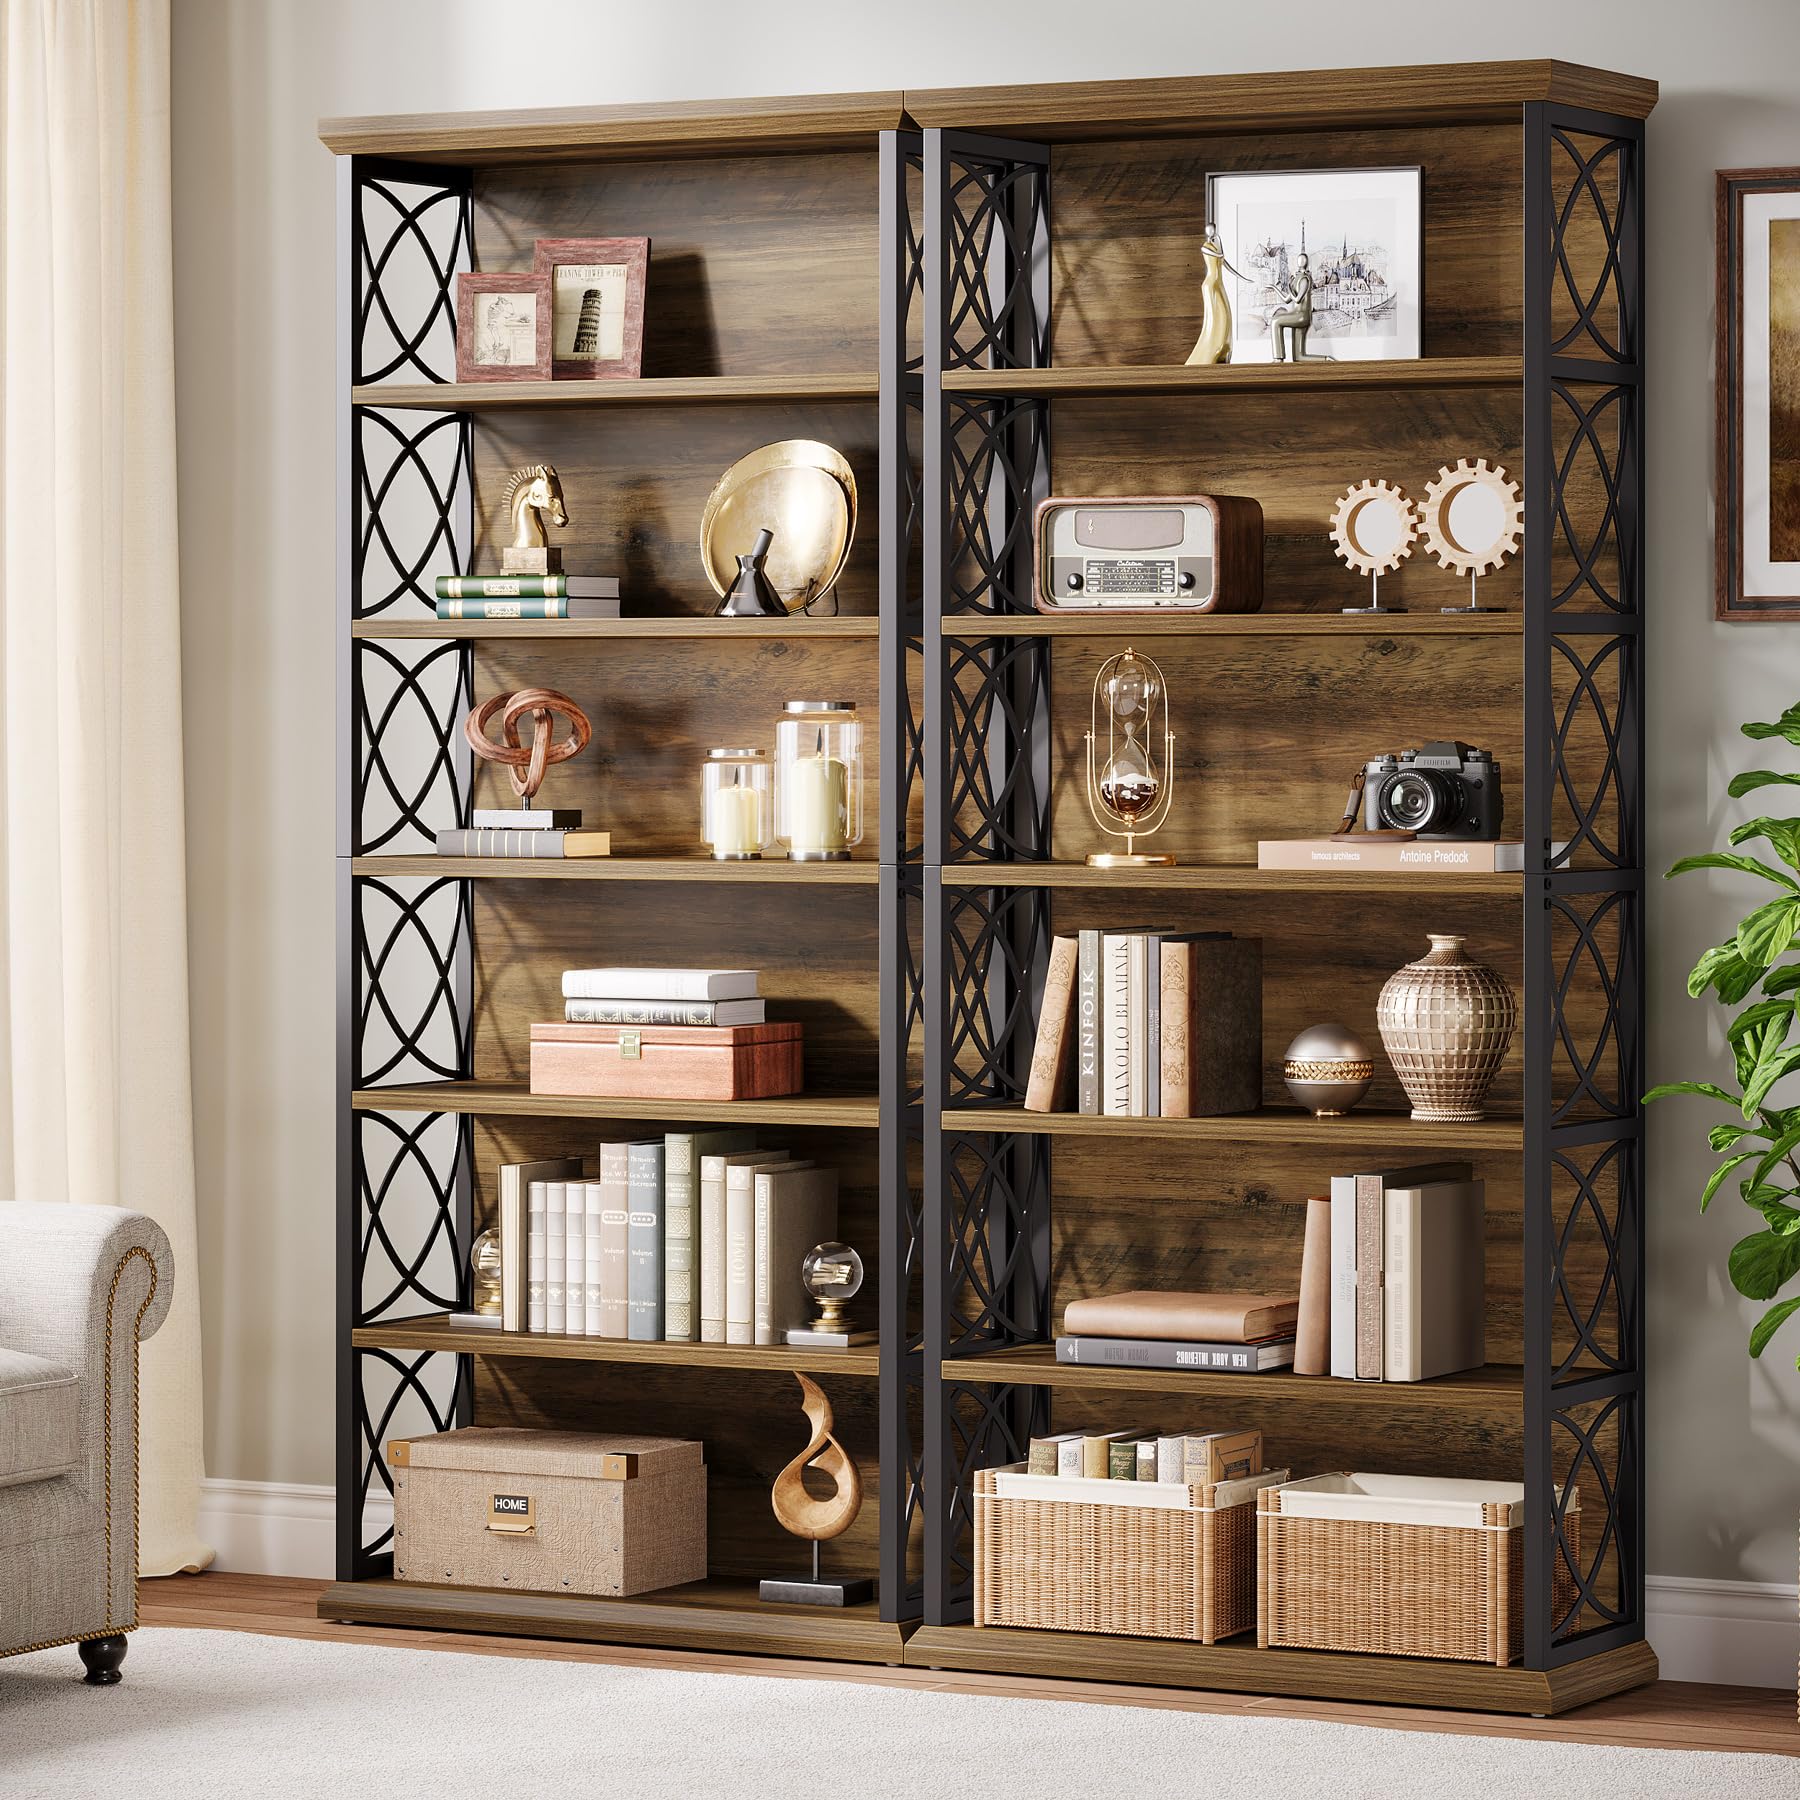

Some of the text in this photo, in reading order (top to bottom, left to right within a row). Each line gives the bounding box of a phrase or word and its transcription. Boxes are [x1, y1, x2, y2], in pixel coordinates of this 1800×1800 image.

[1311, 850, 1360, 861] famous architects
[1400, 850, 1469, 864] Antoine Predock
[1082, 969, 1094, 1077] KINFOLK
[1115, 1025, 1130, 1110] MANOLO
[494, 1498, 527, 1511] HOME
